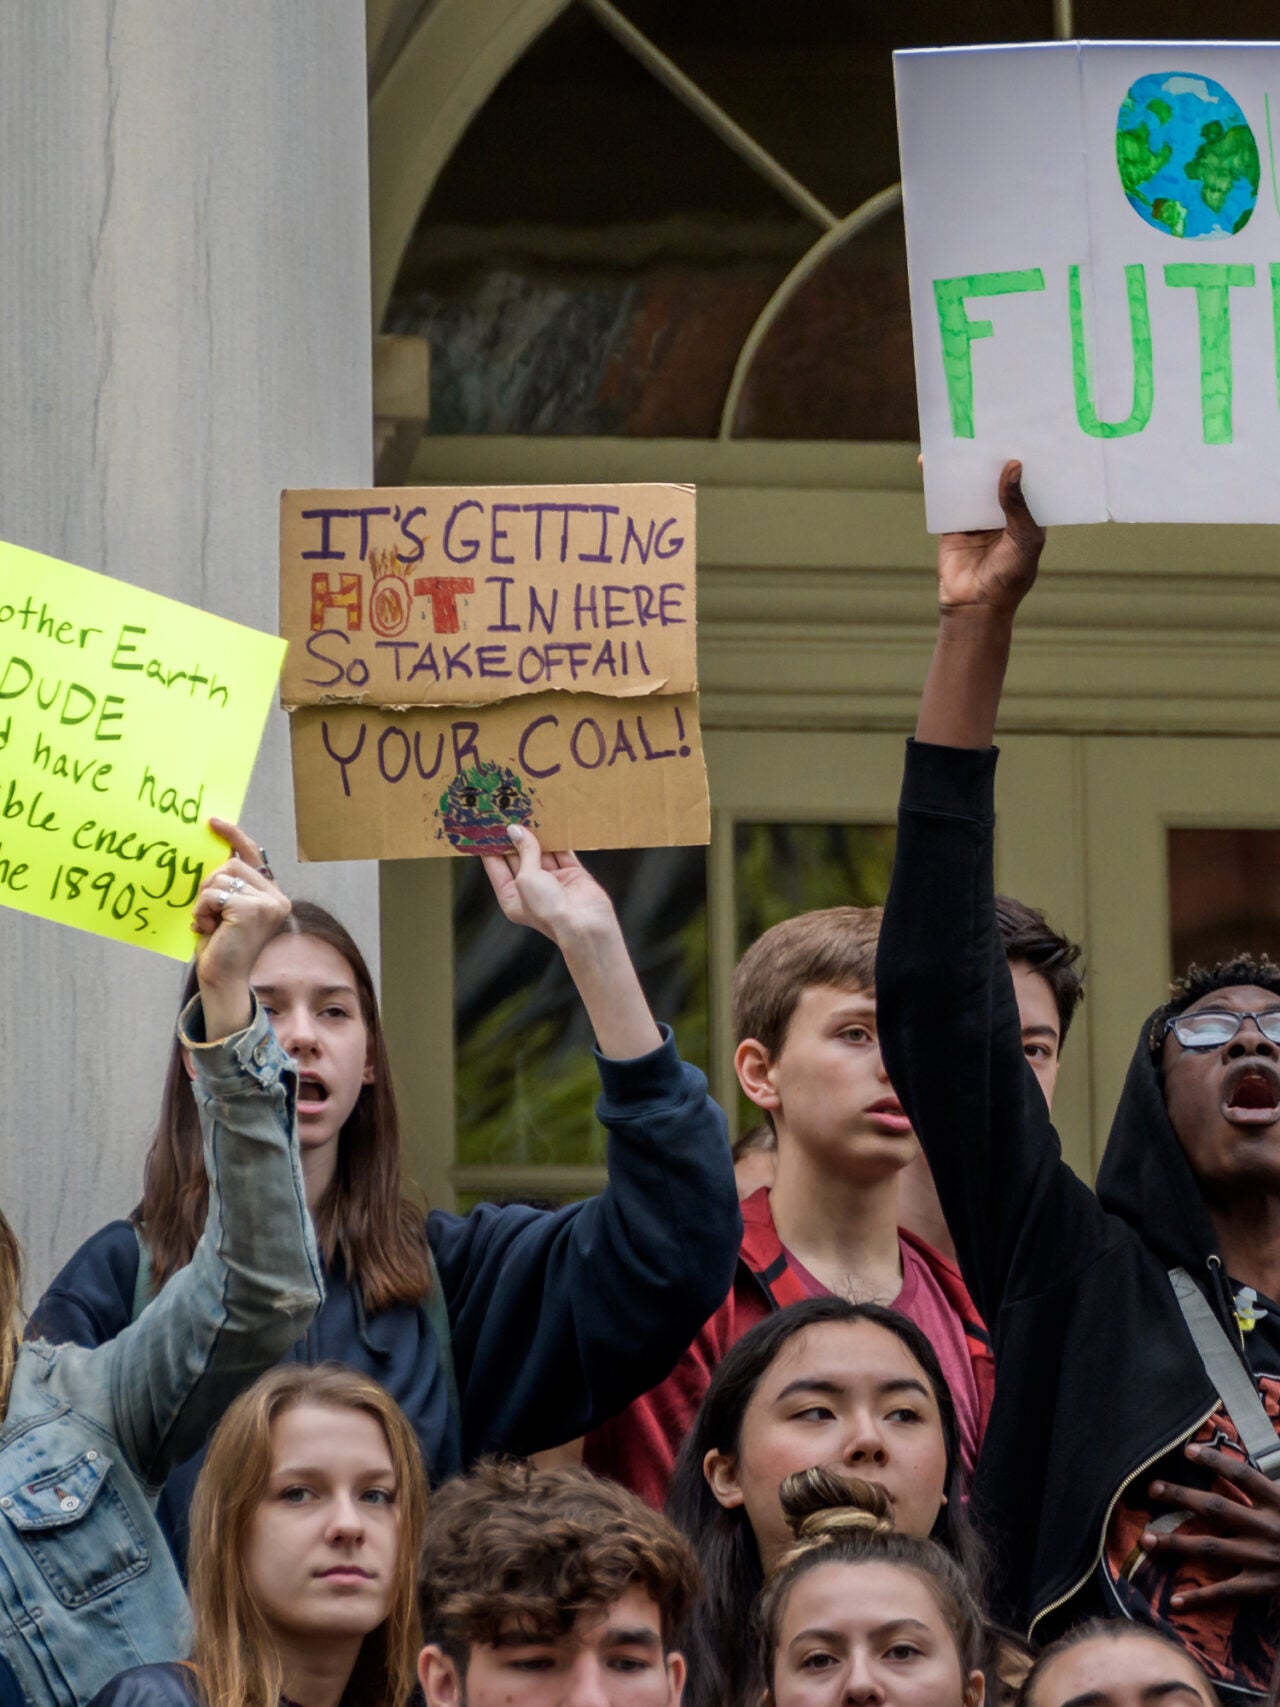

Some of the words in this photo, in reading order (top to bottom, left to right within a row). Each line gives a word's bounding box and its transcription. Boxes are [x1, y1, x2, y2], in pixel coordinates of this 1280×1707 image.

[301, 504, 428, 564] IT'S
[442, 500, 685, 565] GETTING
[310, 571, 476, 638] HOT
[484, 576, 559, 634] IN
[574, 582, 688, 631] HERE
[0, 655, 126, 741] DUDE
[111, 624, 229, 708] Earth
[375, 640, 514, 683] TAKE
[33, 731, 113, 793] have
[138, 765, 204, 824] had
[320, 720, 490, 797] YOUR
[517, 706, 693, 779] COAL!
[72, 819, 204, 908] energy
